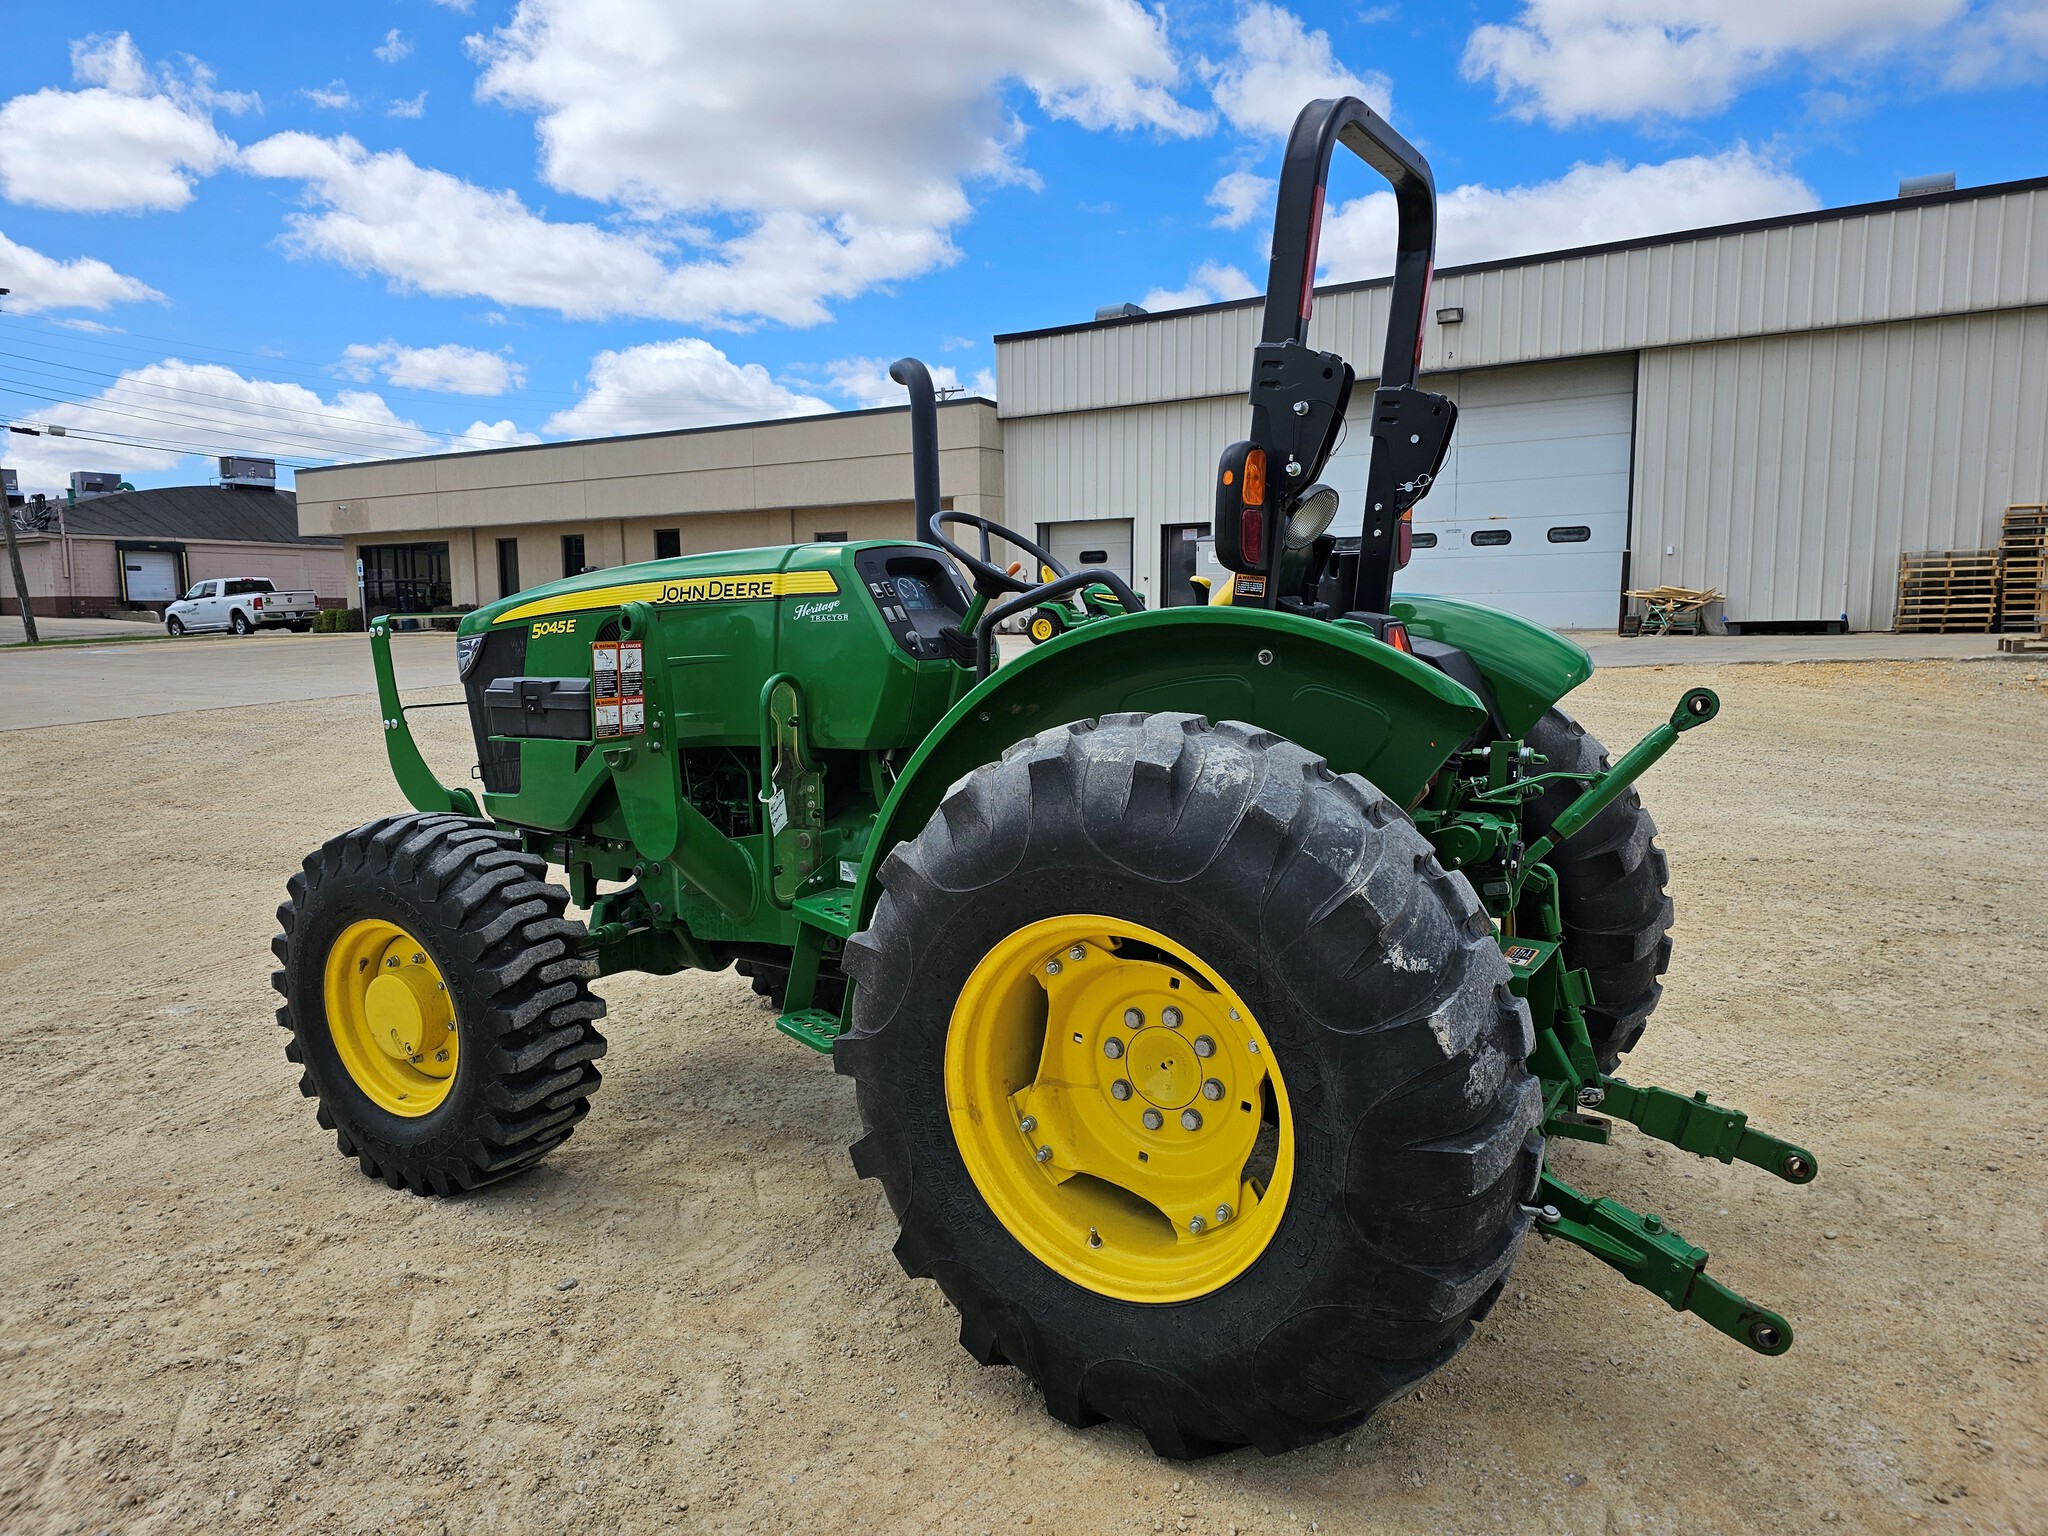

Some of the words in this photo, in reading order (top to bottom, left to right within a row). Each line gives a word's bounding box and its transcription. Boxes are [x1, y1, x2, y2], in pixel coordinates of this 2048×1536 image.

[1448, 351, 1454, 359] 2
[656, 584, 705, 602] JOHN
[708, 581, 773, 597] DEERE
[793, 600, 841, 621] Heritage
[531, 619, 577, 639] 5045E
